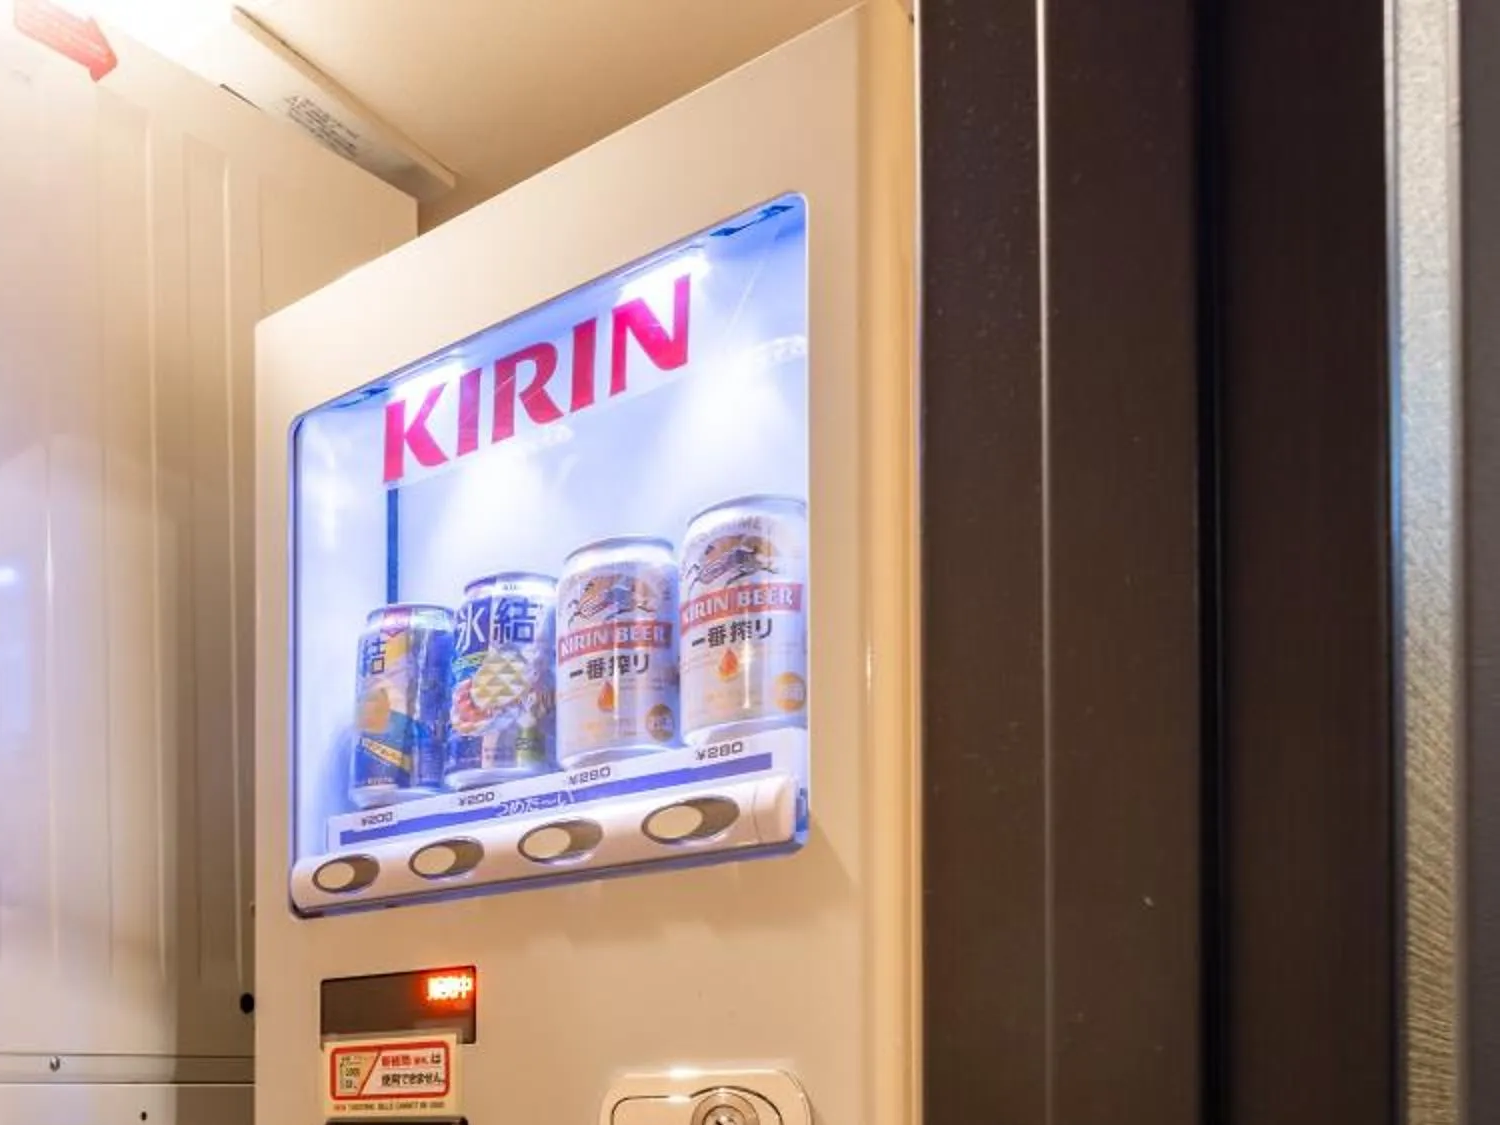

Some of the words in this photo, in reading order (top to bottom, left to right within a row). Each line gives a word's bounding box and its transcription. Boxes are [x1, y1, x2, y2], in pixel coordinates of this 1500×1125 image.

[383, 273, 691, 484] KIRIN
[738, 588, 794, 606] BEER
[455, 597, 537, 650] 氷結
[617, 625, 665, 644] BEER
[691, 618, 772, 647] 一番搾り
[569, 653, 649, 680] 一番搾り
[696, 741, 745, 760] ¥280
